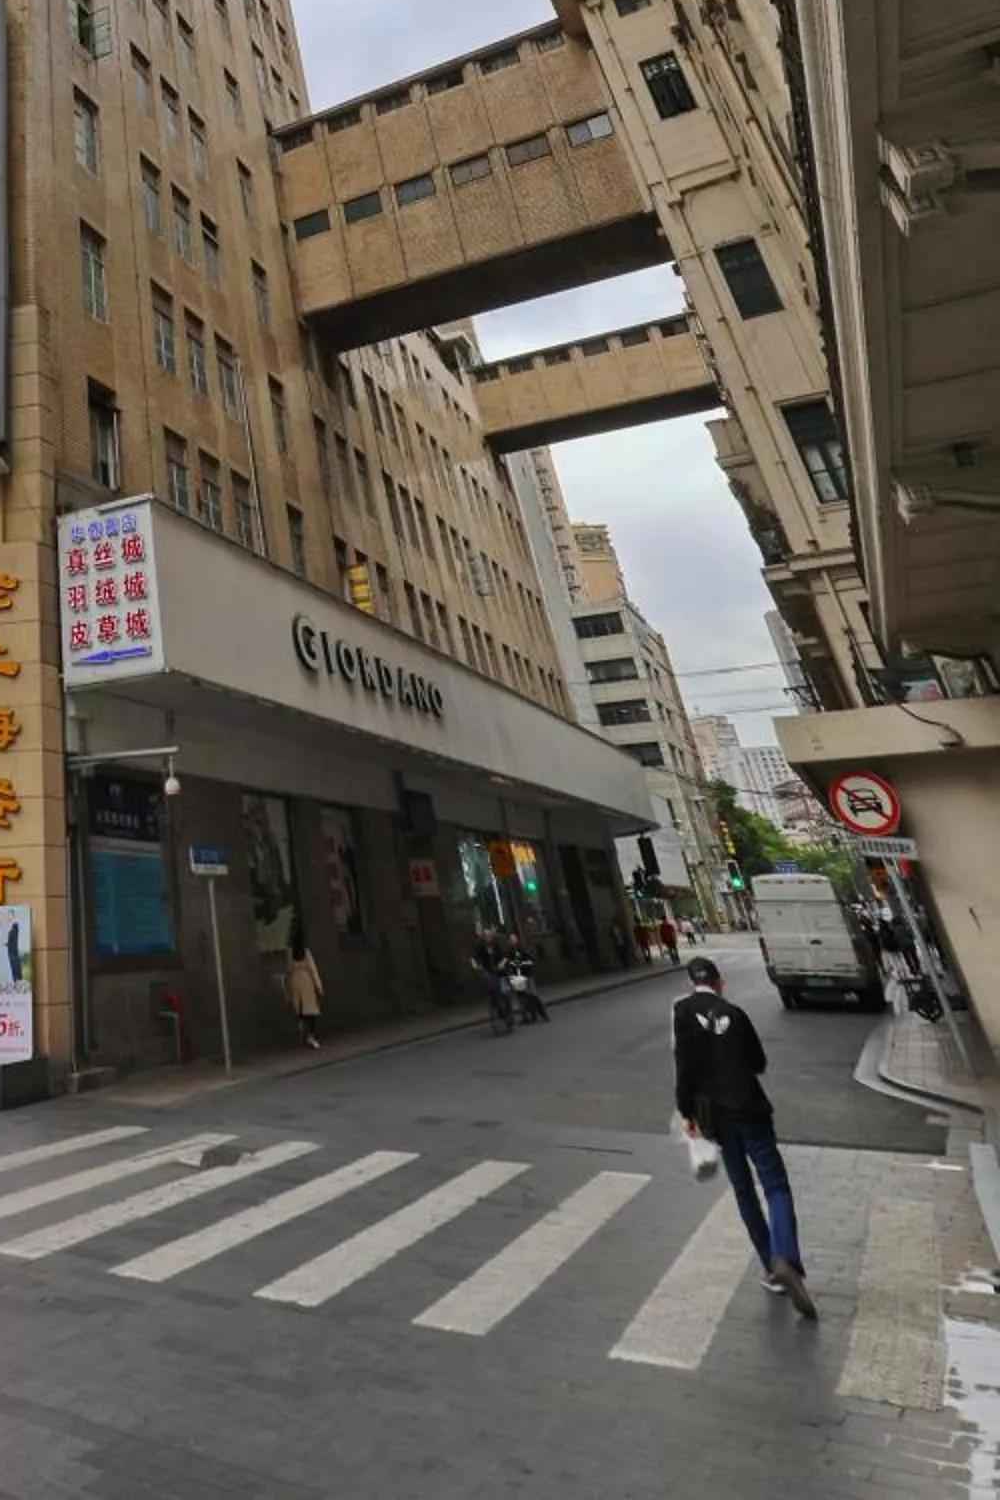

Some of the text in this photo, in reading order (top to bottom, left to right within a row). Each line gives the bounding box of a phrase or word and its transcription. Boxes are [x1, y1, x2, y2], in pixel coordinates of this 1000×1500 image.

[66, 533, 146, 576] 真丝城
[67, 571, 148, 613] 羽绒城
[69, 607, 151, 651] 皮草城
[291, 612, 444, 718] GIORDANO
